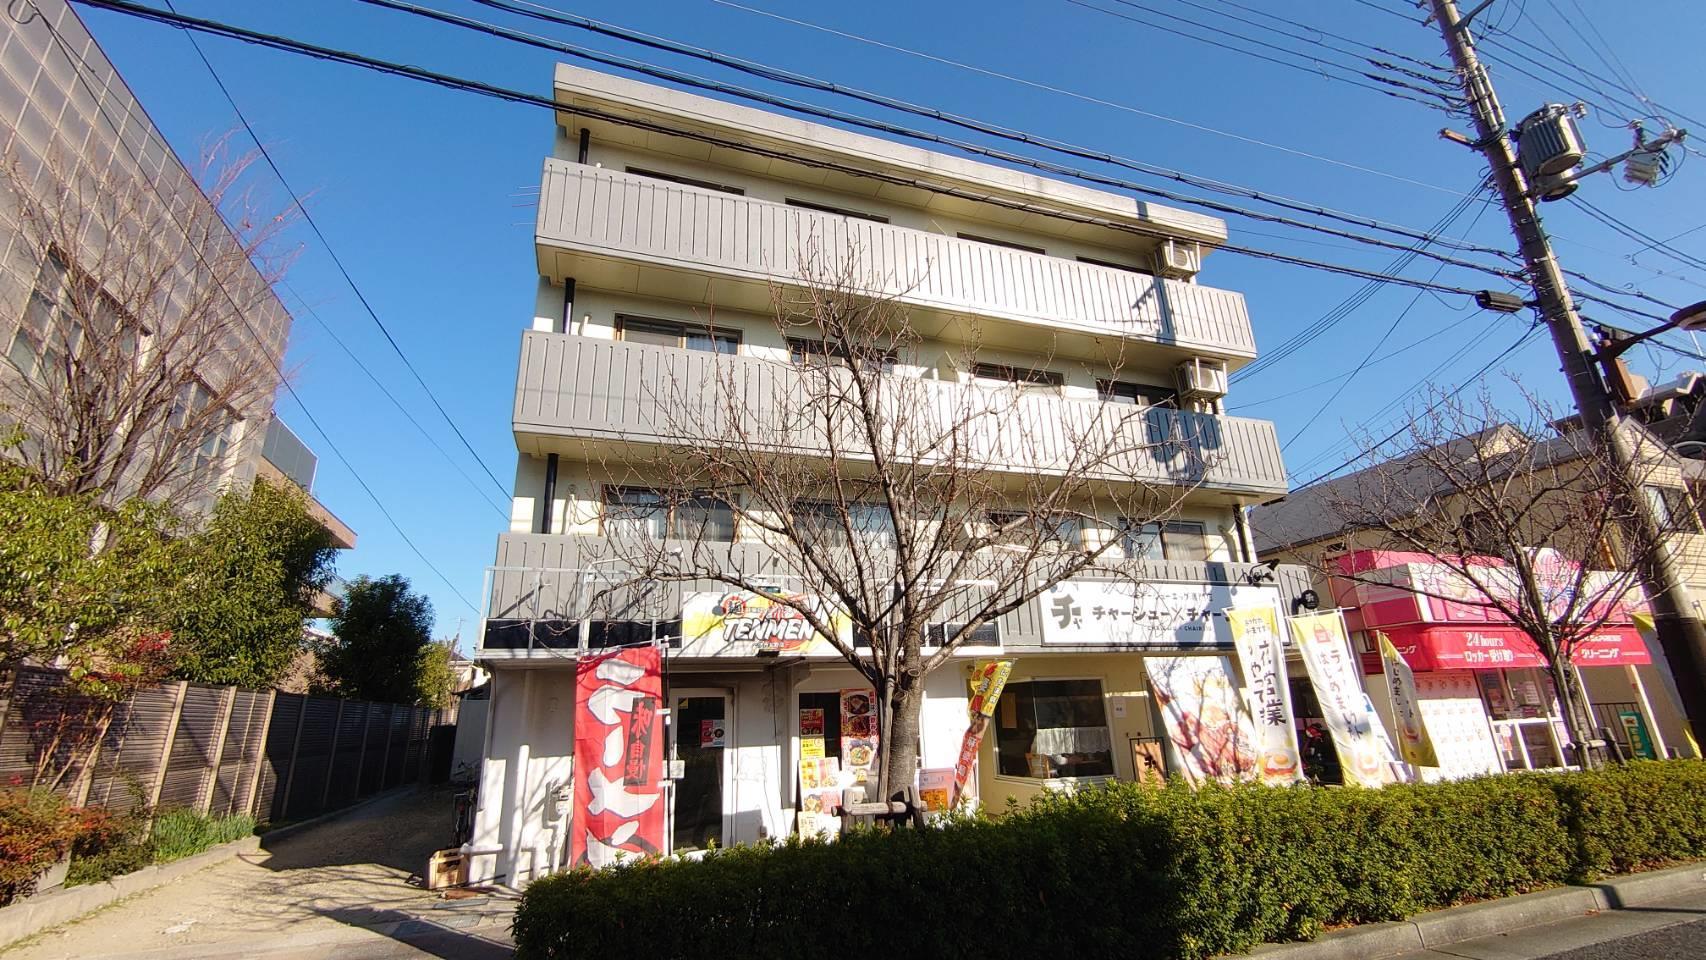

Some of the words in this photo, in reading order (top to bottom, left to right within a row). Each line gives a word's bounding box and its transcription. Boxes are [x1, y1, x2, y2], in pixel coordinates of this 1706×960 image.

[1092, 606, 1231, 622] チャーシュー×チャー
[723, 617, 817, 641] TENMEN
[1581, 647, 1620, 659] クリーニング
